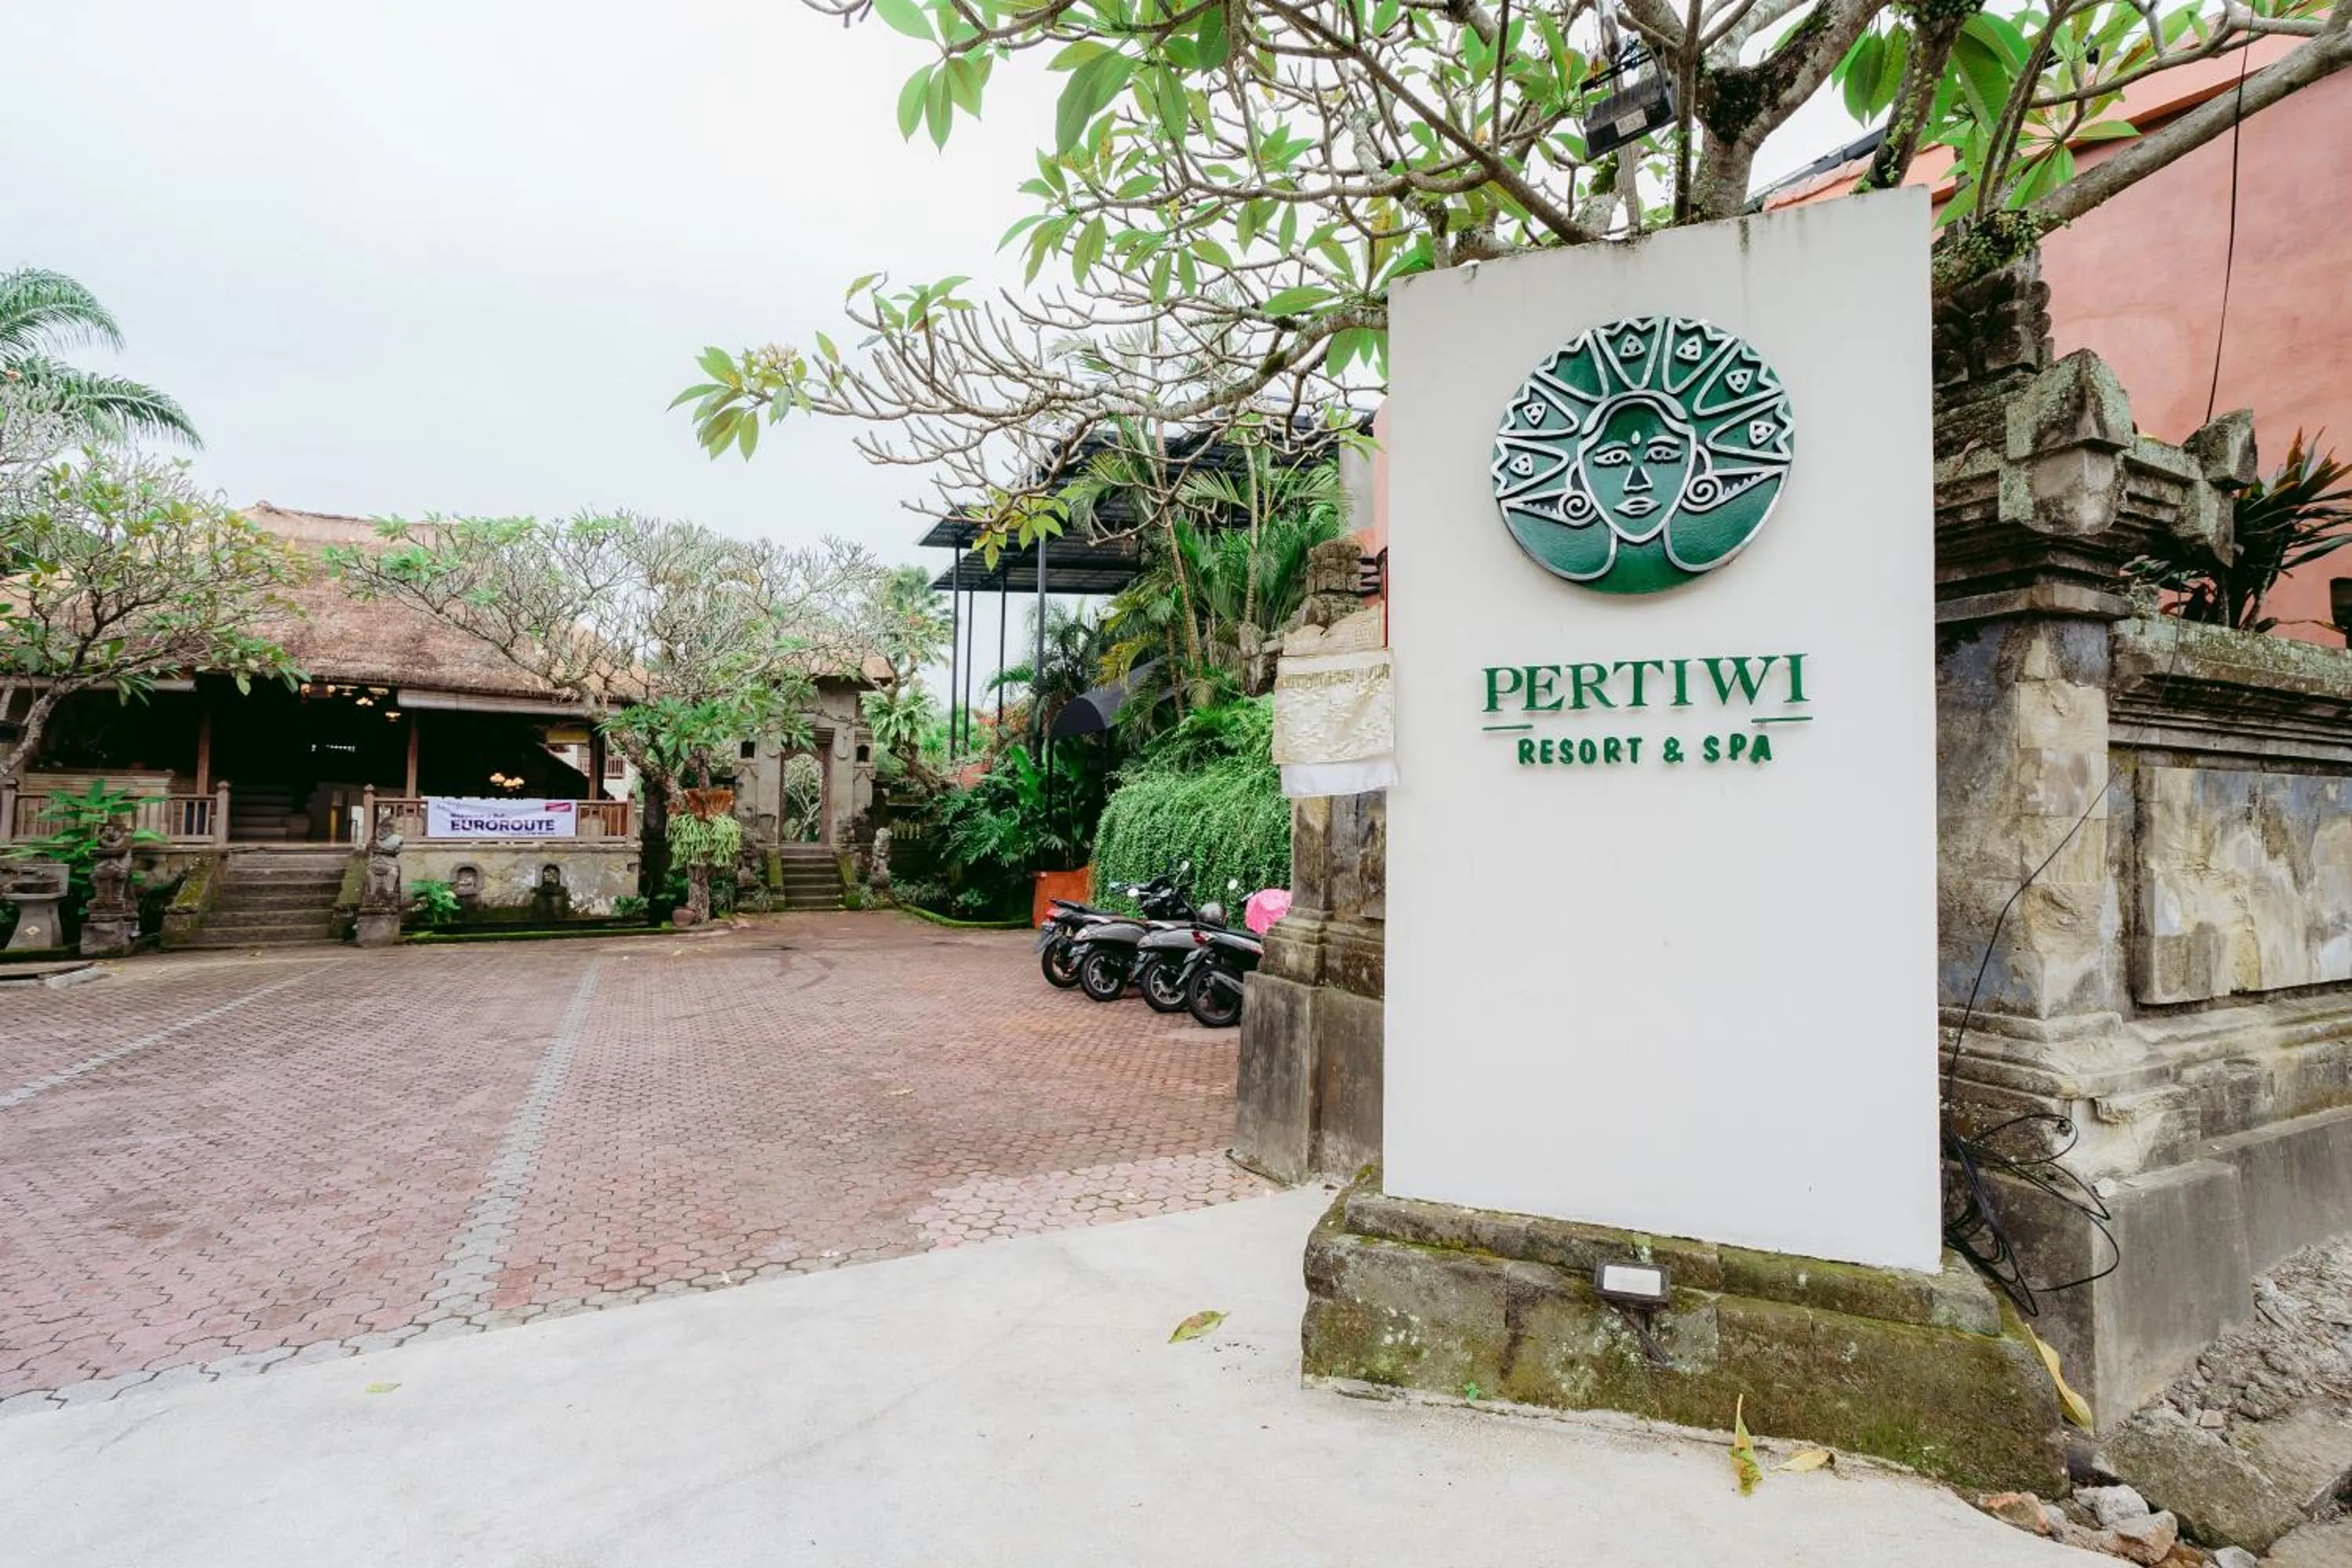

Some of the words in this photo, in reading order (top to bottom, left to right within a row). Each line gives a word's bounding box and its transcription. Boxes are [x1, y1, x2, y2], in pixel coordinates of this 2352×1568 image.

[1482, 653, 1809, 712] PERTIWI
[1517, 736, 1643, 765] RESORT
[1662, 736, 1685, 764] &
[1703, 733, 1773, 764] SPA
[451, 819, 555, 831] EUROROUTE
